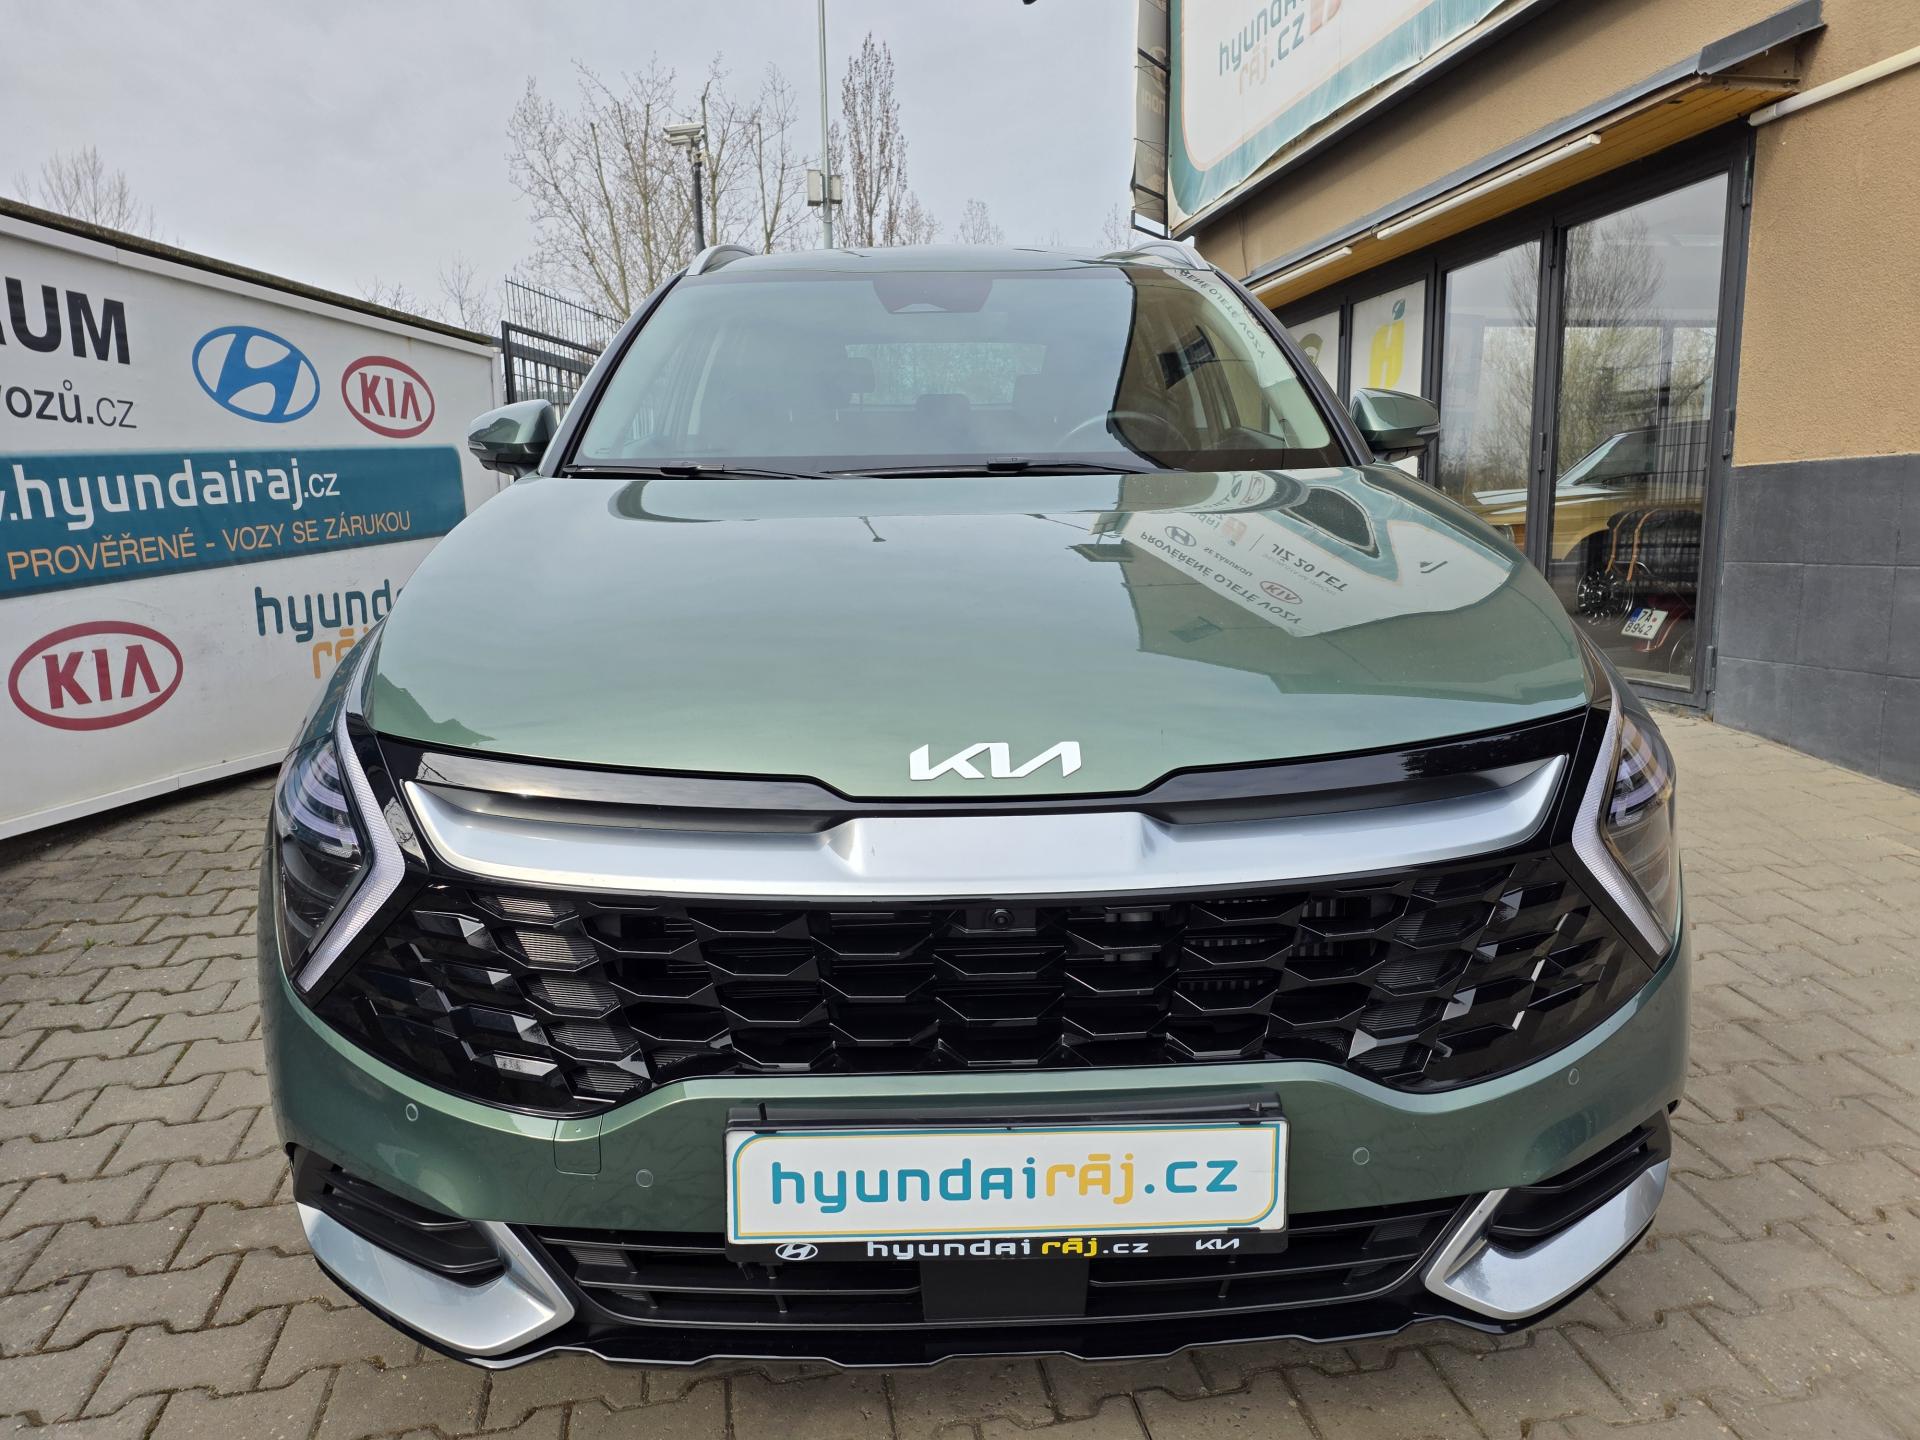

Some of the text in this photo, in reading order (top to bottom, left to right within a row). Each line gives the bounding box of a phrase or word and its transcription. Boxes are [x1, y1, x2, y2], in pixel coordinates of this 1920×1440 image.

[0, 276, 131, 365] UM
[0, 379, 138, 428] ozů.cz
[358, 371, 424, 422] KIA
[7, 527, 197, 581] PROVĚŘENÉ
[222, 523, 285, 552] VOZY
[292, 520, 320, 544] SE
[324, 511, 411, 540] ZÁRUKOU
[254, 578, 404, 643] hyund
[1625, 622, 1653, 636] 8942
[42, 644, 161, 709] KIA
[909, 741, 1082, 780] KIA
[1195, 1238, 1240, 1252] KIA
